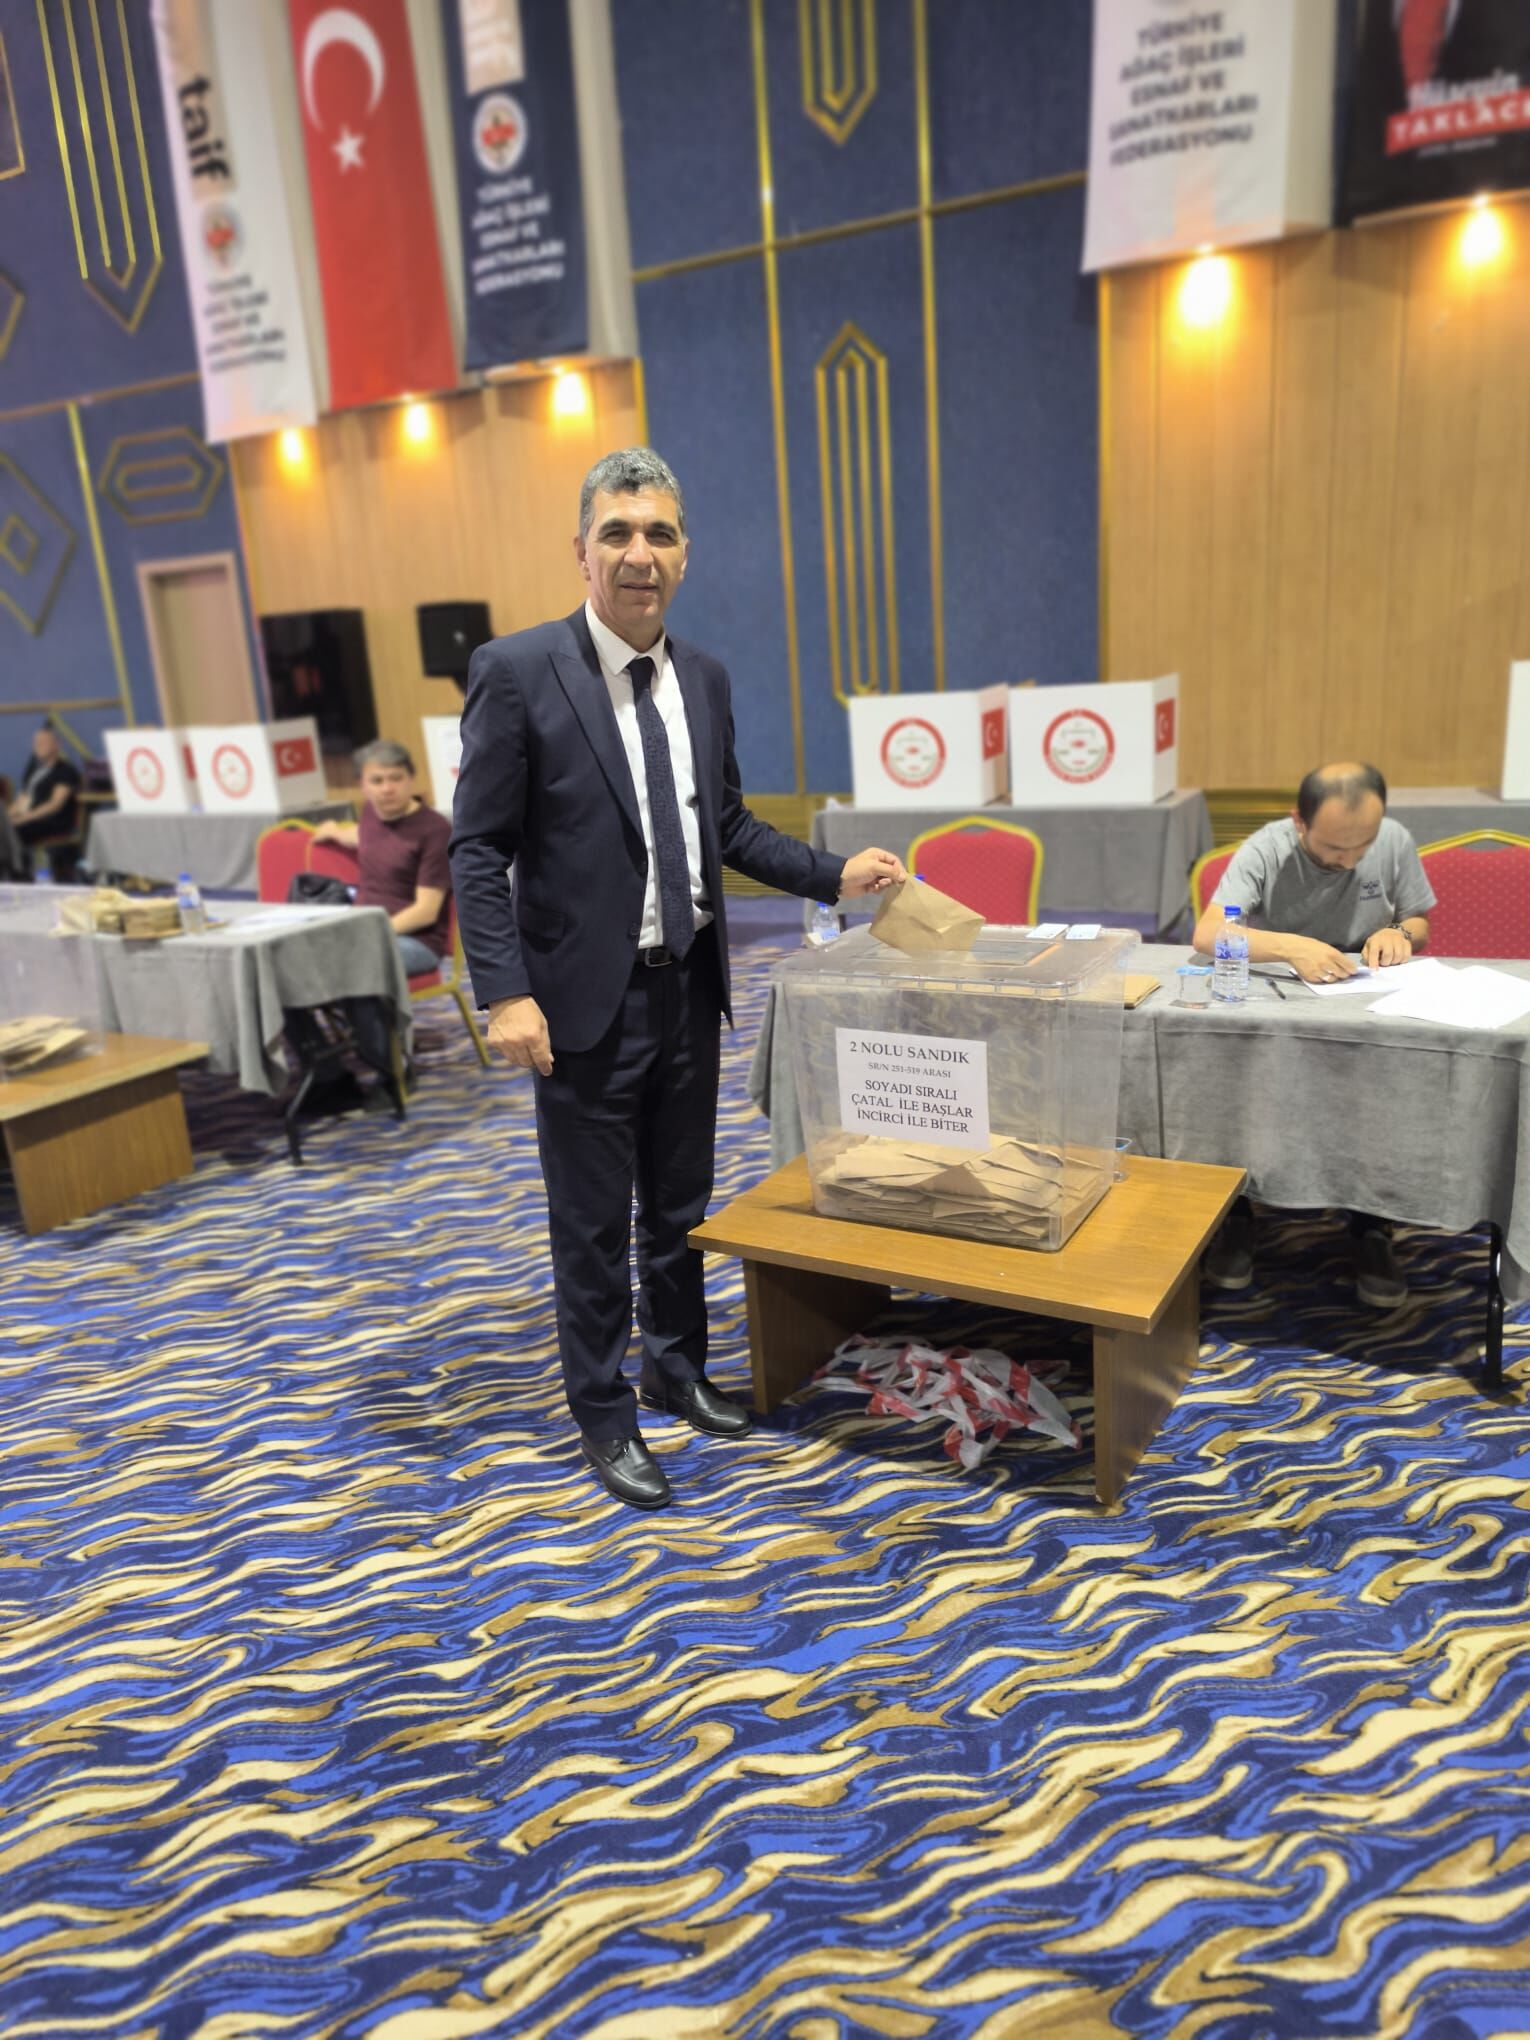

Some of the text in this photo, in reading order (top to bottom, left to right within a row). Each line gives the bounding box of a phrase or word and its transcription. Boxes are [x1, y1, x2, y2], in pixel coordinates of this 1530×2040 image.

[1199, 69, 1225, 91] VE
[178, 76, 231, 178] taif
[850, 1041, 970, 1064] 2 NOLU SANDIK
[923, 1068, 951, 1078] ARASI
[865, 1080, 957, 1100] SOYADI SIRALI
[851, 1093, 973, 1118] ÇATAL İLE BAŞLAR
[857, 1107, 969, 1133] İNCİRCİ İLE BİTER
